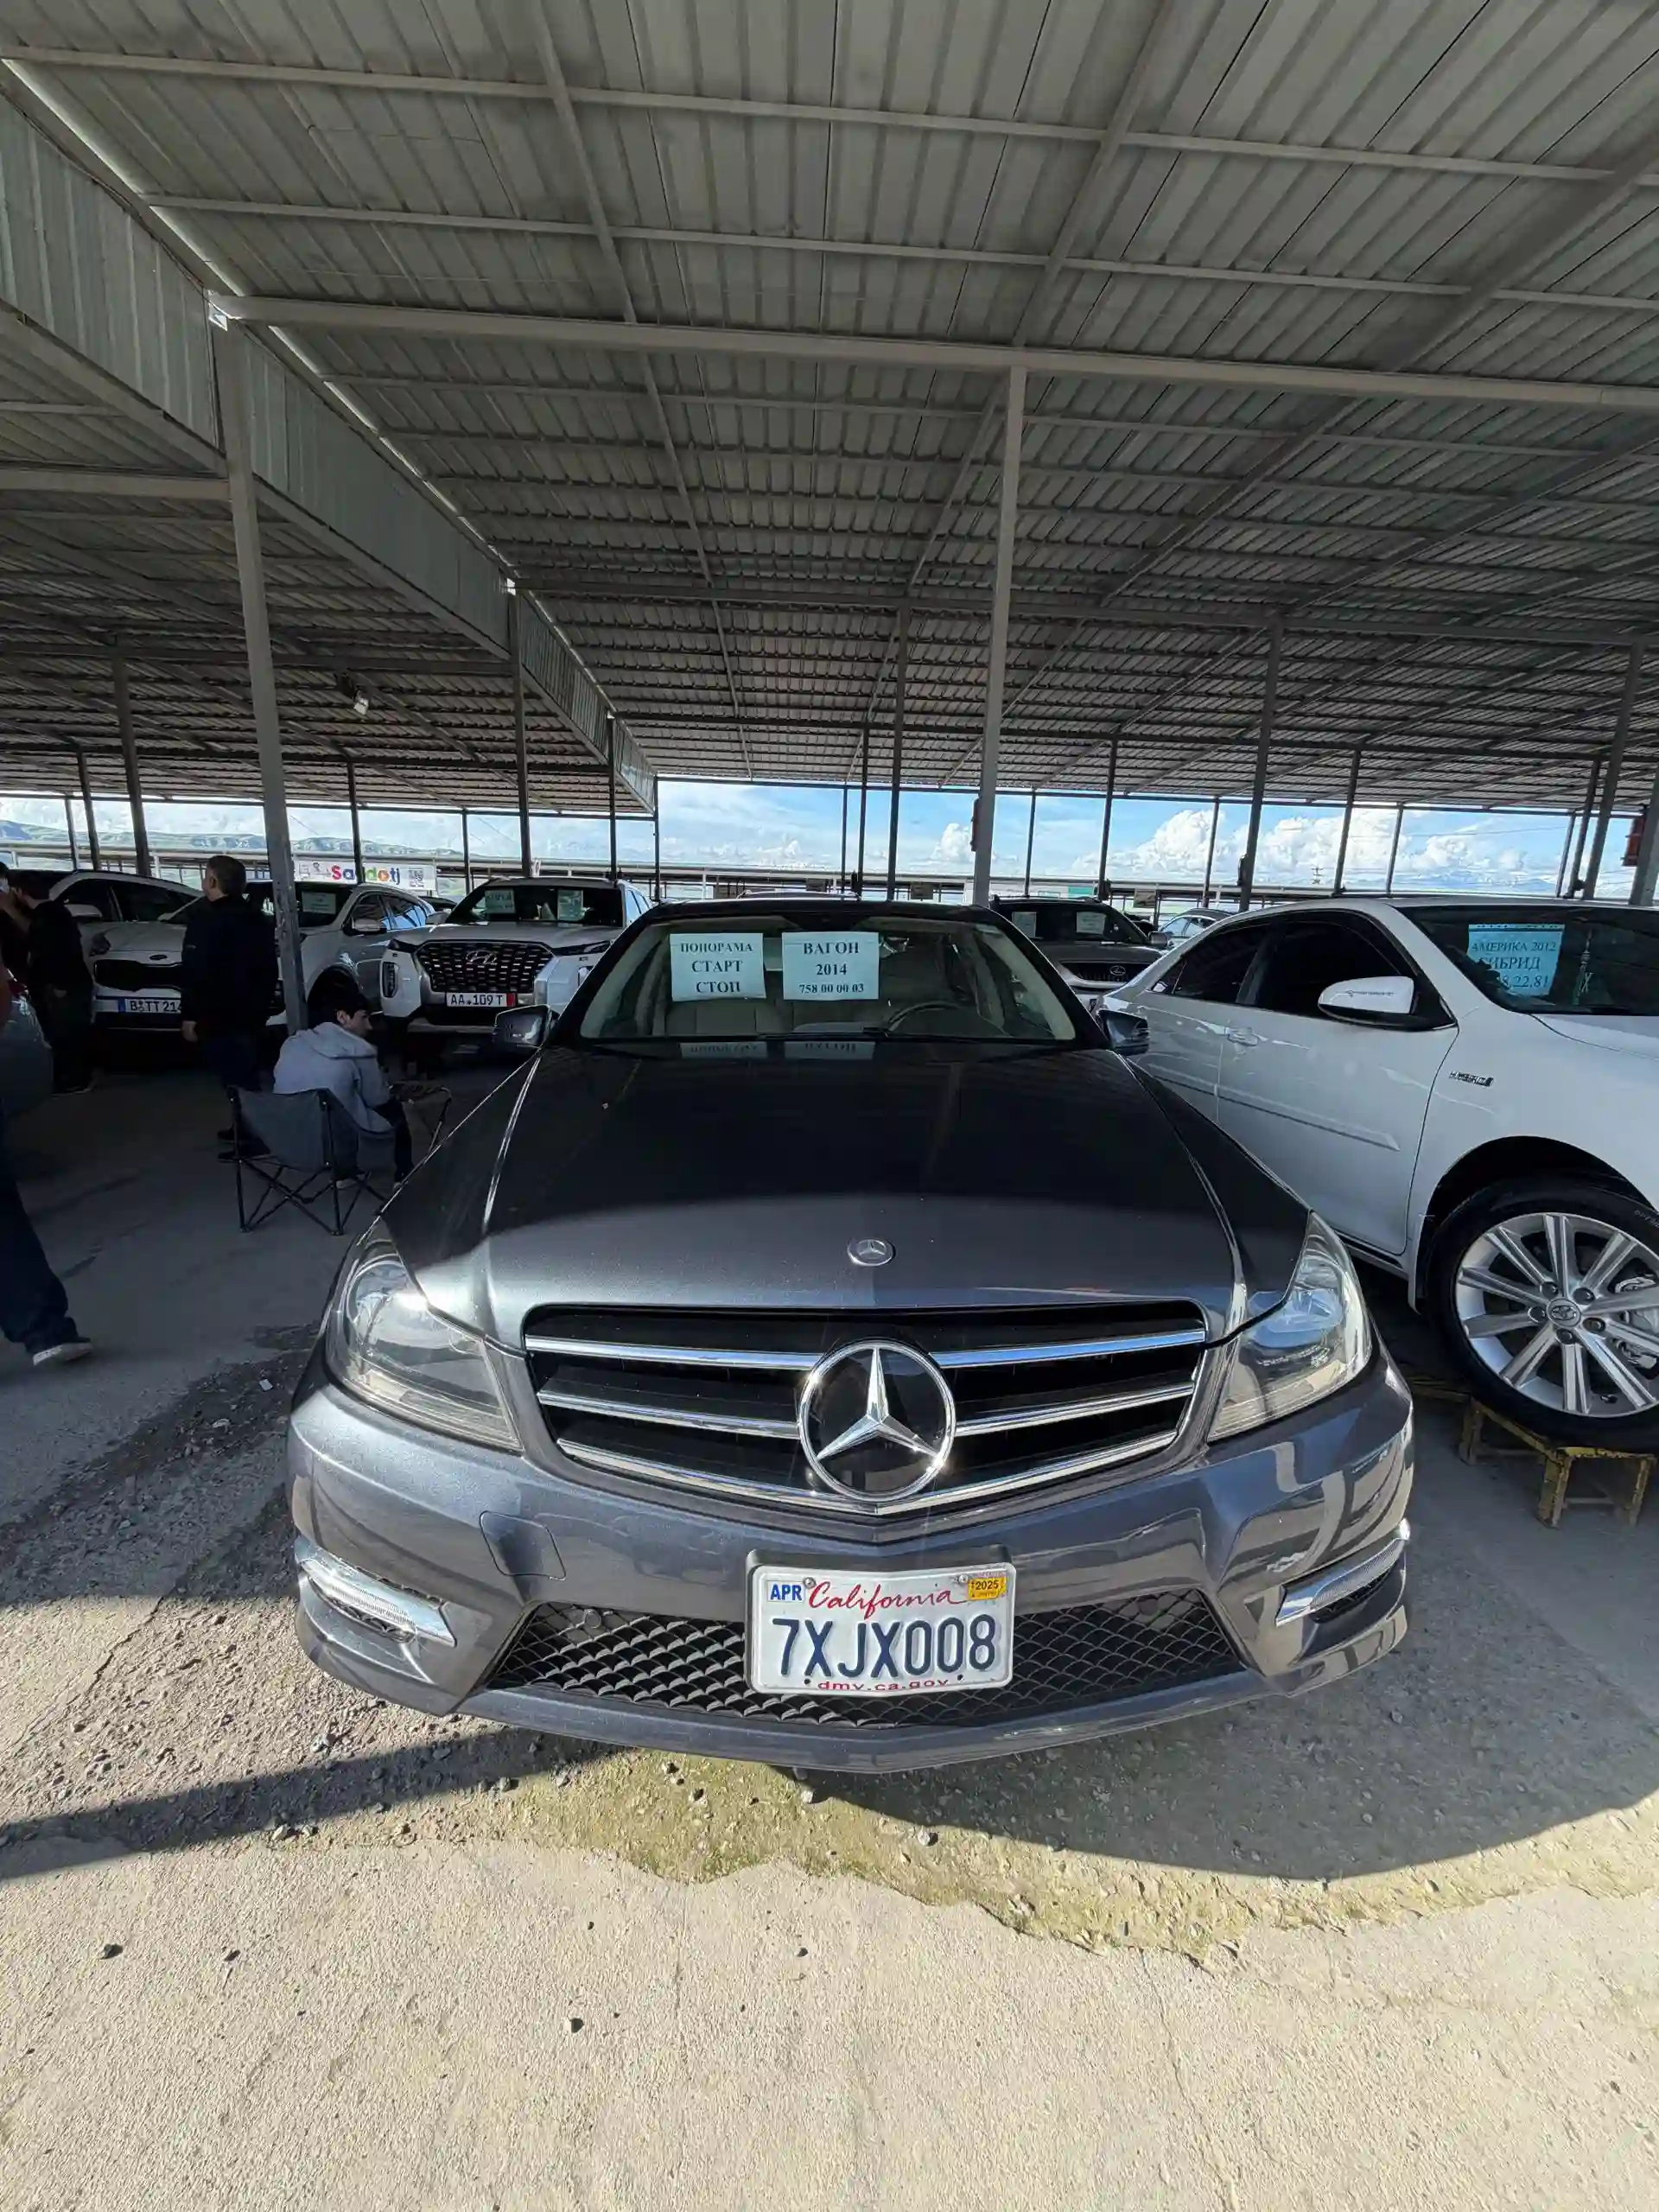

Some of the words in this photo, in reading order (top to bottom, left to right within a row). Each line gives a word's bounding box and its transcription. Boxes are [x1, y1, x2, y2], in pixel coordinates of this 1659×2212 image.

[331, 865, 401, 886] Sado.tj
[803, 942, 859, 955] ВАГОН
[1471, 941, 1528, 952] АМЕРИКА
[1531, 941, 1557, 952] 2012
[691, 960, 743, 973] СТАРТ
[816, 963, 848, 976] 2014
[1483, 957, 1541, 971] ИБРИД
[696, 981, 741, 994] СТОП
[798, 984, 817, 994] 758
[130, 1001, 137, 1011] B
[145, 1001, 160, 1012] TT
[451, 995, 465, 1005] AA
[474, 995, 493, 1005] 109
[498, 995, 504, 1005] T
[770, 1584, 802, 1601] APR
[808, 1582, 966, 1619] California
[975, 1580, 1000, 1591] 2025
[772, 1613, 995, 1679] 7XJX008
[818, 1680, 949, 1691] dmv.ca.gov
